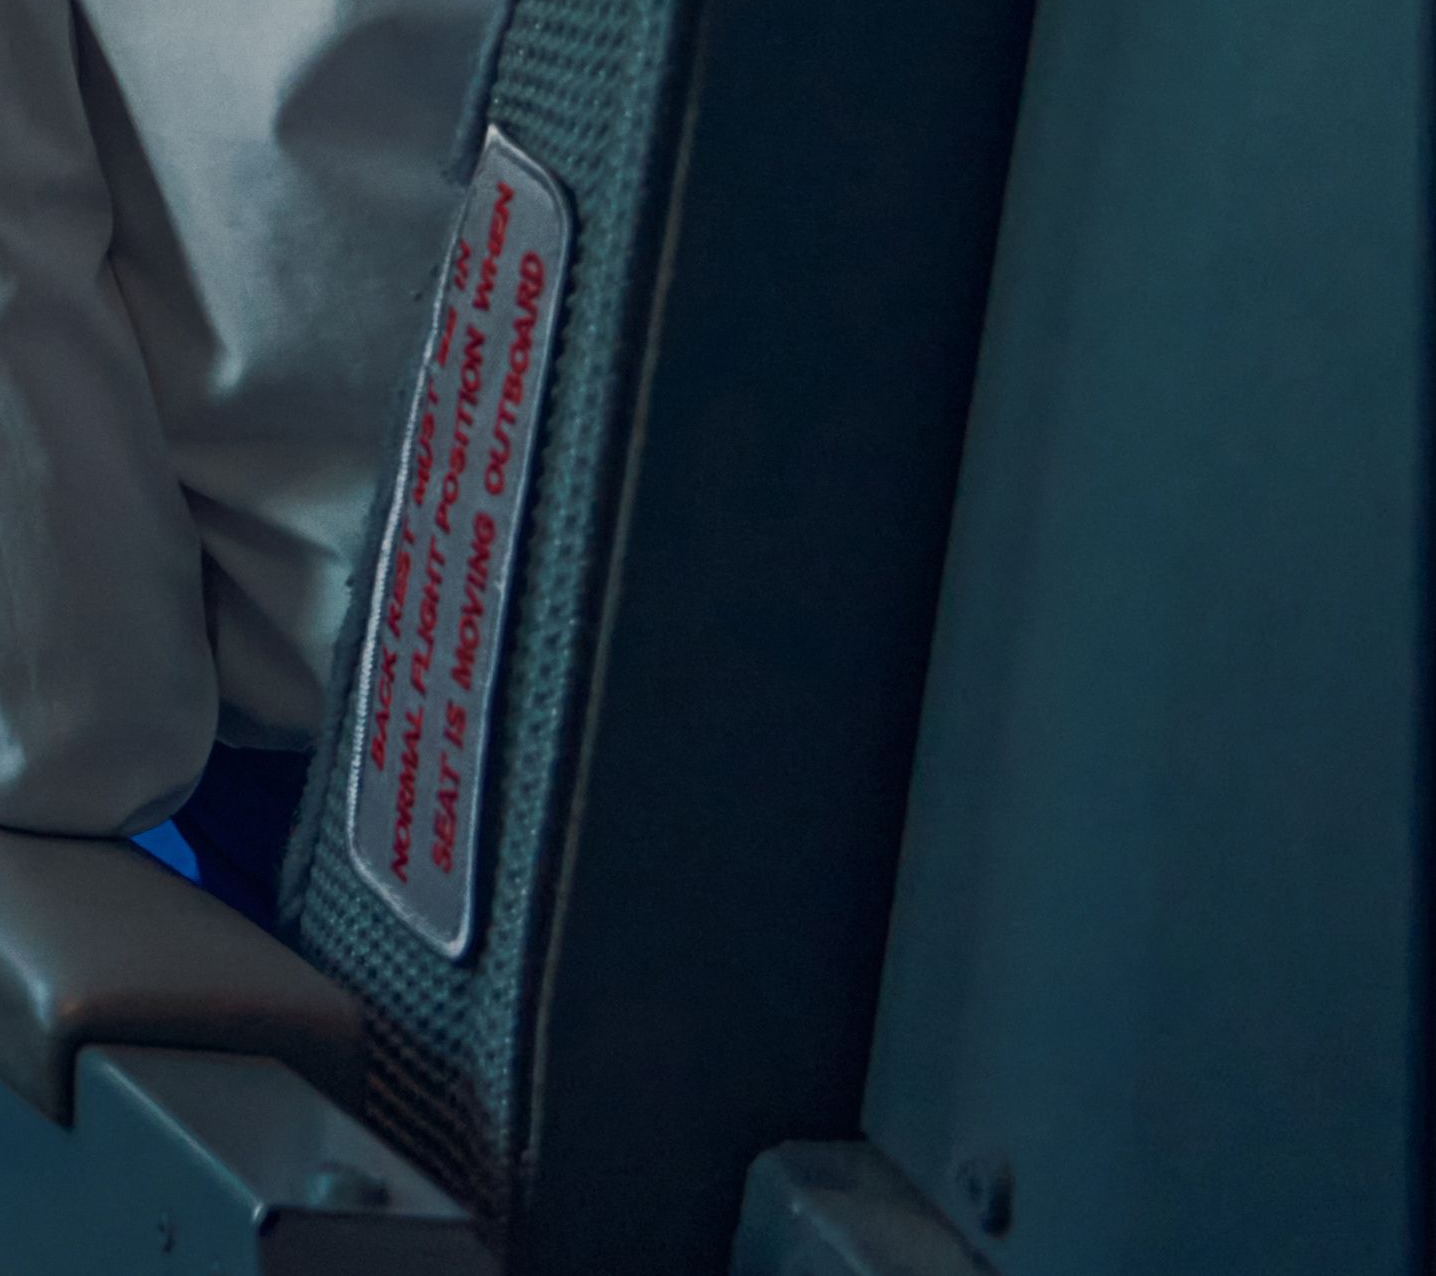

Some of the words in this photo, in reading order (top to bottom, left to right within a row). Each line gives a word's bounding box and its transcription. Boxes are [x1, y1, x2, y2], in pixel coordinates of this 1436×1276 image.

[483, 250, 545, 496] OUTBOARD
[370, 644, 398, 773] BACK
[387, 515, 415, 640] REST
[411, 376, 440, 507] MUST
[452, 237, 472, 292] IN
[390, 705, 424, 885] NORMAL
[409, 534, 446, 698] FLIGHT
[433, 321, 487, 535] POSITION
[472, 179, 516, 313] WHEN
[449, 510, 497, 692] MOVING
[430, 751, 461, 875] SEAT
[442, 698, 468, 749] IS
